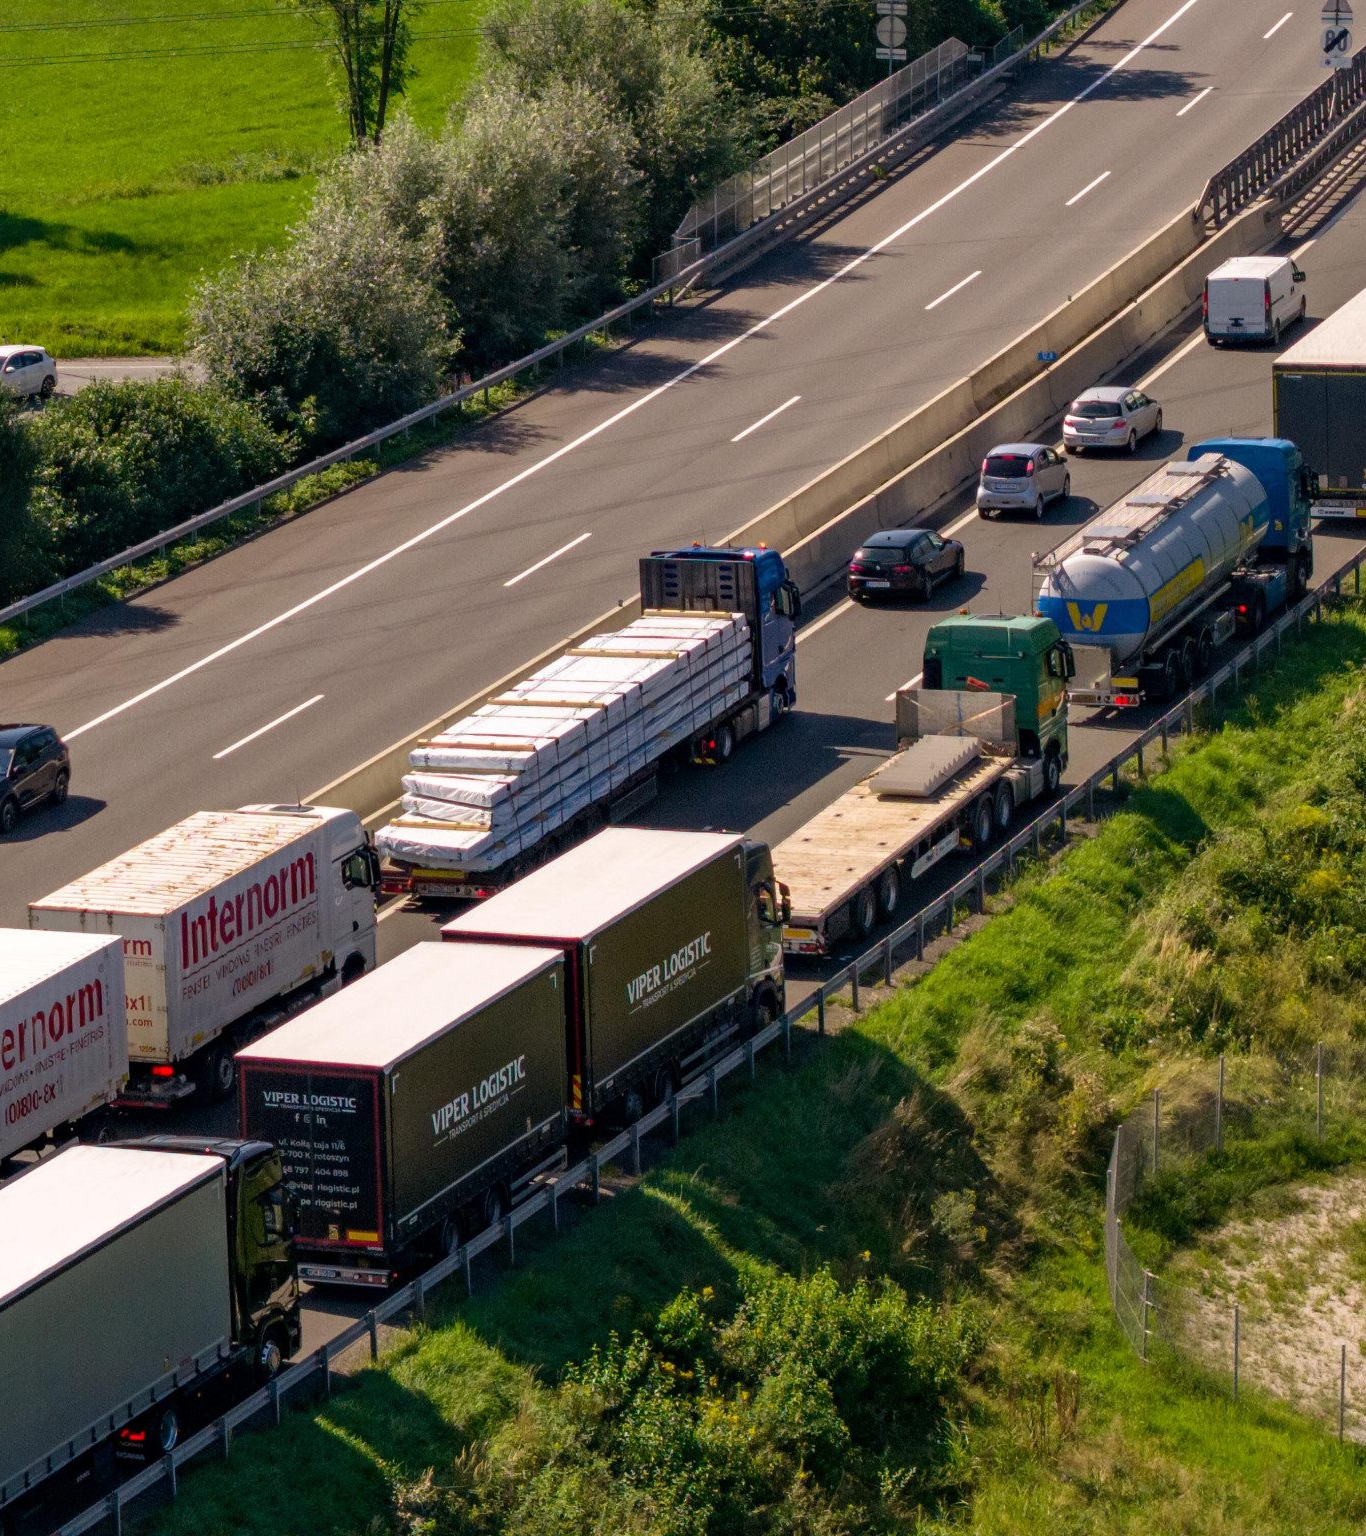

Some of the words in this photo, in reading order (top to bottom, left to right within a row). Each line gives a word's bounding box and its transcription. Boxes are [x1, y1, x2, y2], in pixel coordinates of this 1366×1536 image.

[181, 851, 316, 969] Internorm
[627, 964, 661, 1004] VIPER
[663, 931, 712, 981] LOGISTIC
[263, 1091, 300, 1104] VIPER
[303, 1094, 357, 1108] LOGISTIC
[431, 1092, 469, 1135] VIPER
[472, 1054, 526, 1109] LOGISTIC
[448, 1112, 479, 1140] TRANSPORT
[280, 1150, 304, 1158] 3-700
[331, 1140, 346, 1150] 11/6
[294, 1166, 309, 1174] 797
[333, 1169, 349, 1177] 898
